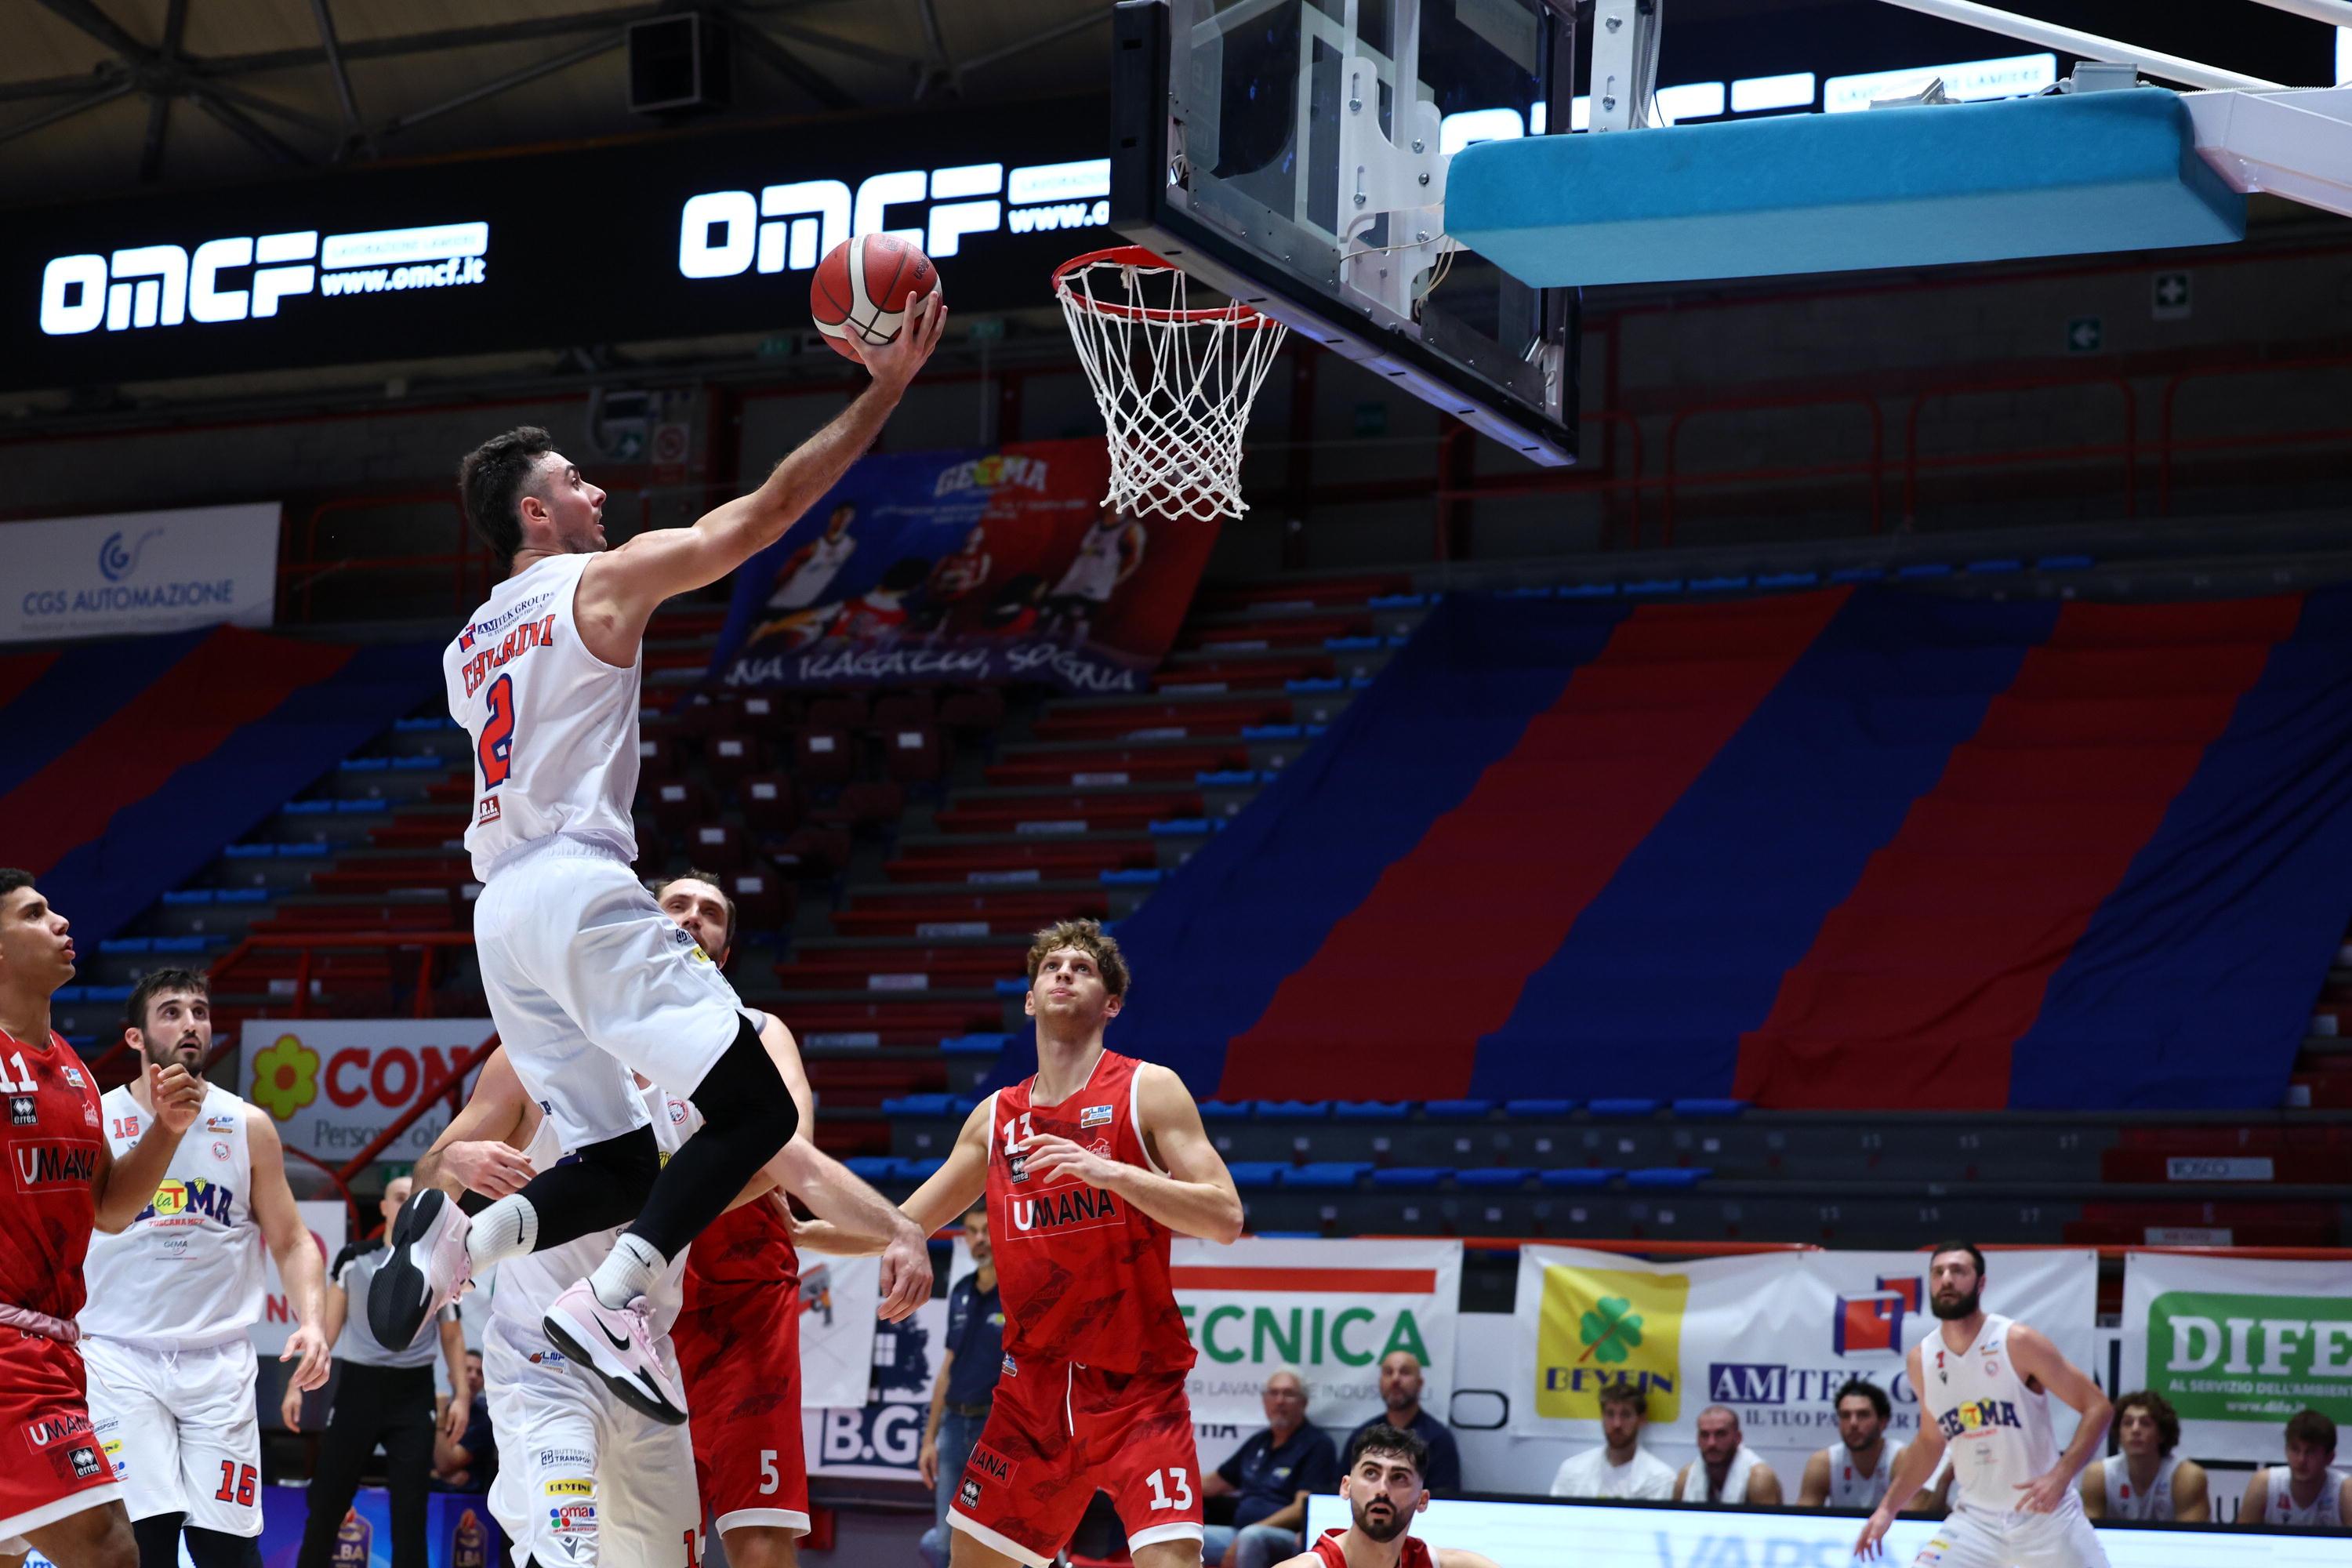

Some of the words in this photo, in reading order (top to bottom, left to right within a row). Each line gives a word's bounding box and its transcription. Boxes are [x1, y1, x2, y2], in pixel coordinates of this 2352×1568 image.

[320, 256, 486, 296] www.omcf.it
[21, 590, 67, 615] CGS
[72, 579, 234, 612] AUTOMAZIONE
[477, 672, 515, 792] 2
[113, 1116, 140, 1139] 15
[1003, 1111, 1035, 1156] 13
[1014, 1187, 1116, 1231] UMANA
[2169, 1379, 2186, 1392] AL
[2190, 1380, 2253, 1394] SERVIZIO
[1771, 1410, 1811, 1427] TUO
[759, 1450, 779, 1495] 5
[1145, 1468, 1193, 1511] 13
[560, 1506, 589, 1518] oma
